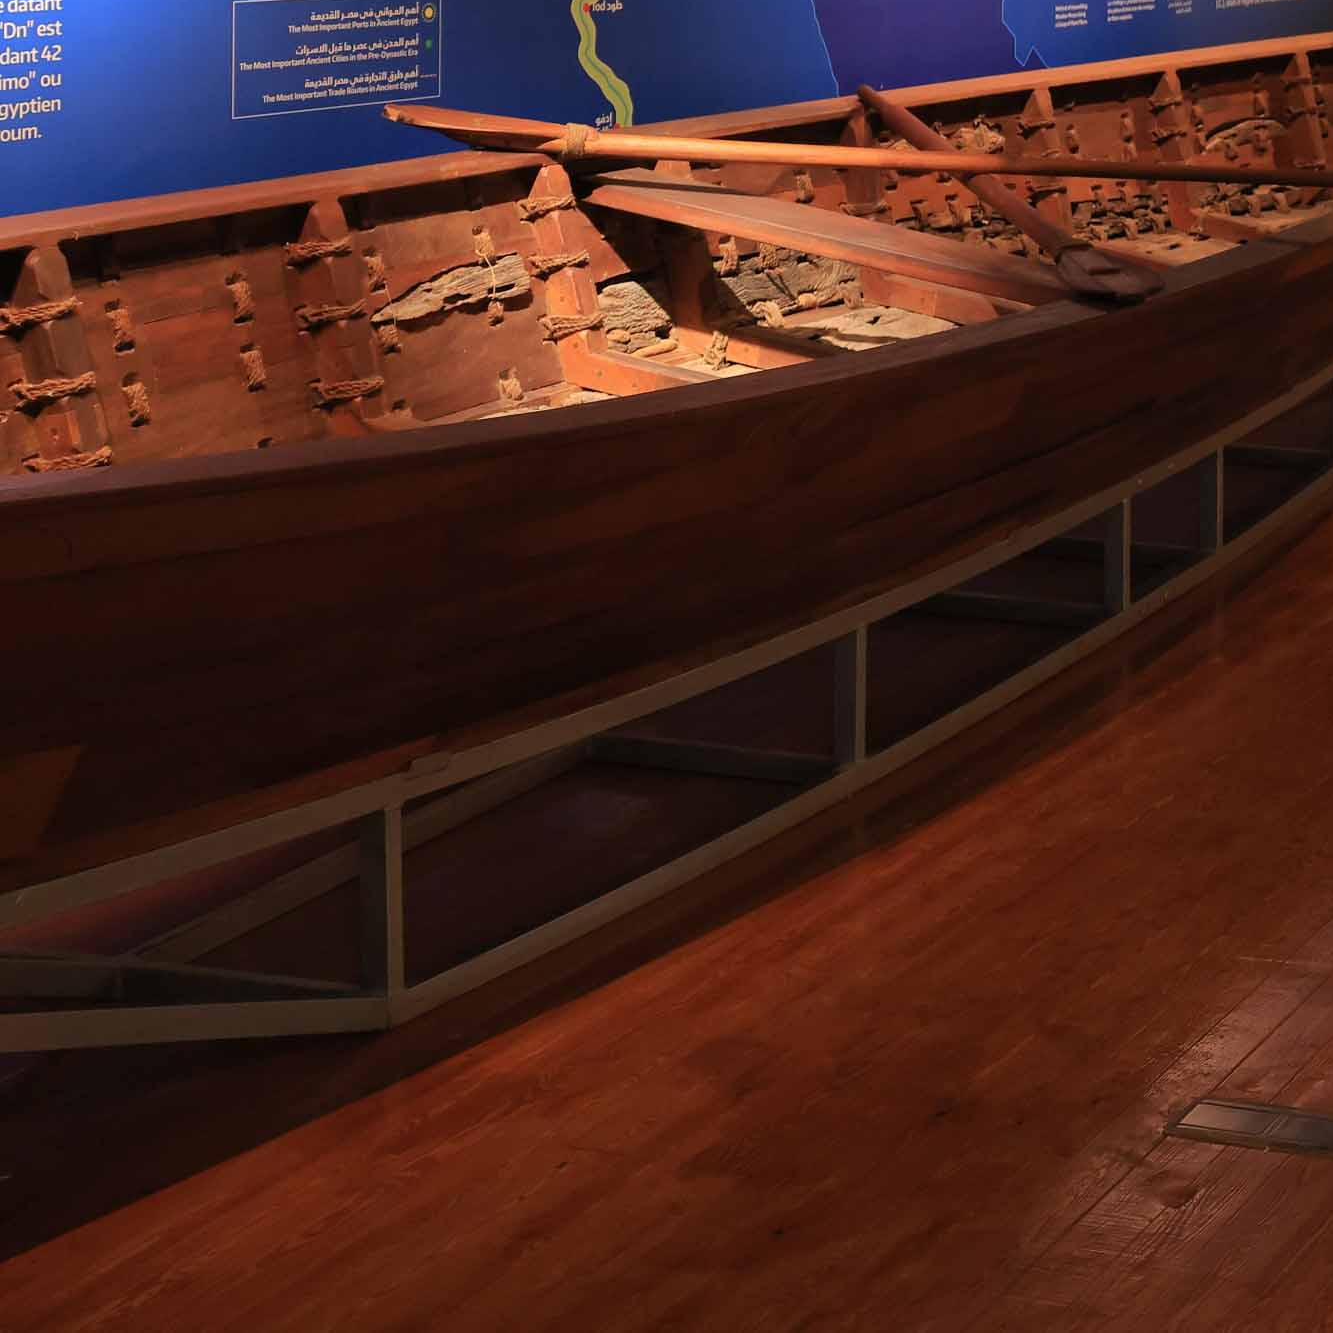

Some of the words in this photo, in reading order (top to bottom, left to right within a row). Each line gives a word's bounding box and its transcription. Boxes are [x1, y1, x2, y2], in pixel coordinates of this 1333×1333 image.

[591, 2, 605, 12] Tod
[37, 19, 63, 37] est
[287, 25, 301, 34] The
[301, 24, 319, 33] Most
[319, 22, 352, 32] Important
[376, 19, 400, 27] Ancient
[400, 17, 418, 27] Egypt
[41, 44, 62, 62] 42
[240, 62, 253, 71] The
[253, 61, 272, 70] Most
[272, 58, 305, 69] Important
[305, 55, 331, 65] Ancient
[332, 54, 349, 63] Cities
[356, 53, 368, 61] the
[368, 50, 407, 60] Pre-Dynastic
[40, 73, 62, 87] ou
[263, 94, 276, 103] The
[276, 93, 294, 102] Most
[294, 89, 328, 101] Important
[328, 88, 346, 96] Trade
[346, 87, 369, 95] Routes
[376, 83, 400, 92] Ancient
[400, 81, 418, 91] Egypt
